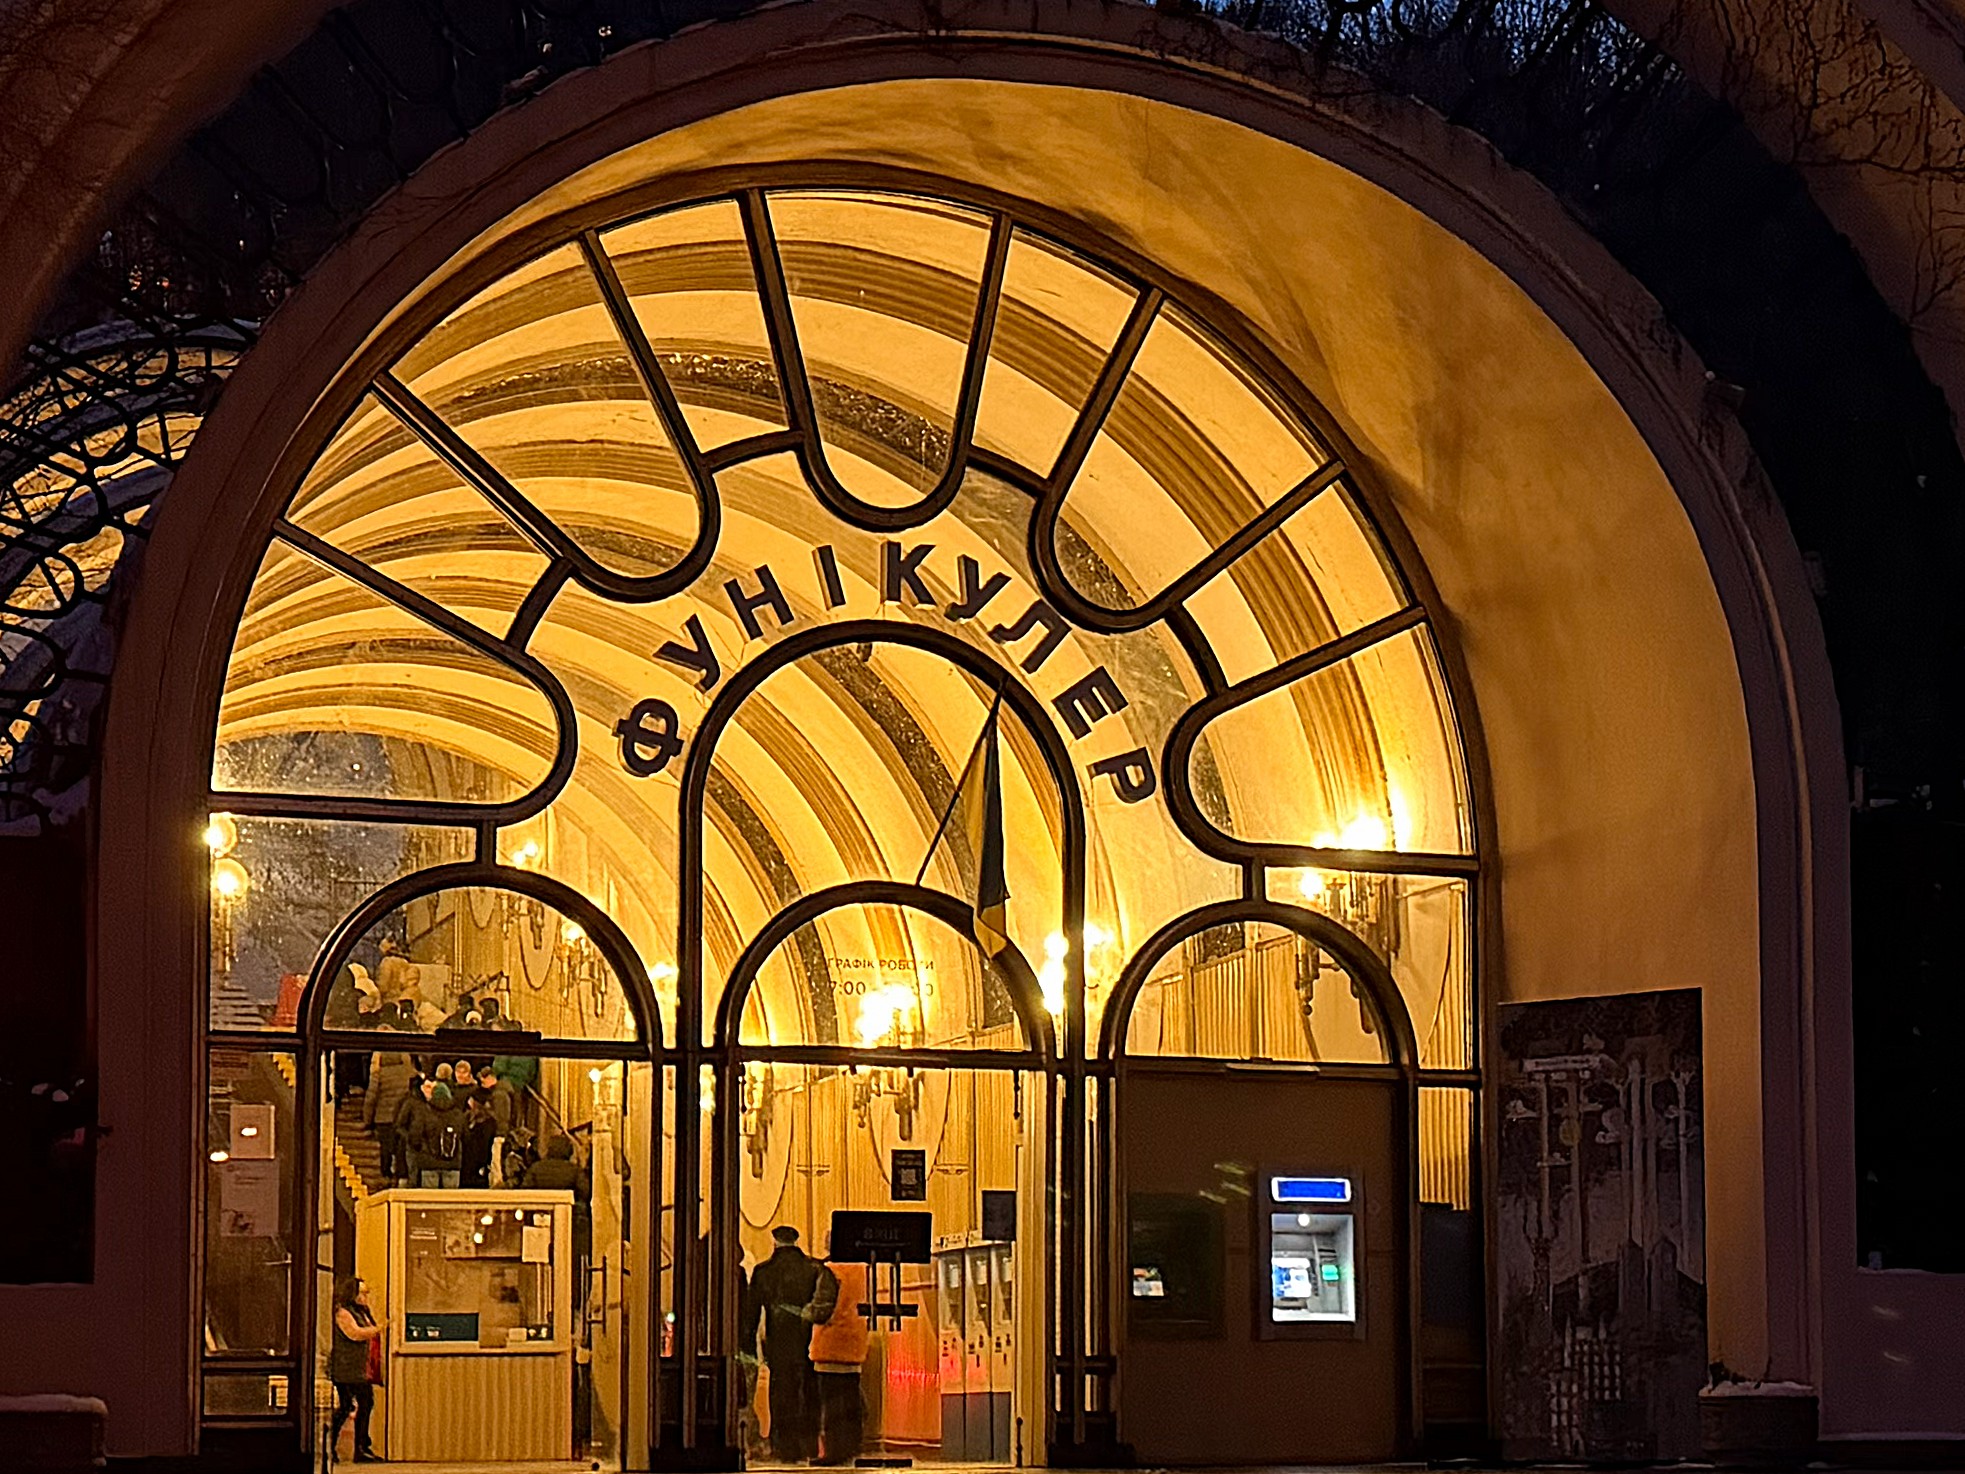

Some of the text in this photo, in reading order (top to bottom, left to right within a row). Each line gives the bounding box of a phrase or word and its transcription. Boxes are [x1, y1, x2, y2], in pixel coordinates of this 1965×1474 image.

[613, 541, 1157, 804] ФУНІКУЛЕР
[827, 957, 934, 971] ГРАФІК РОБОИ
